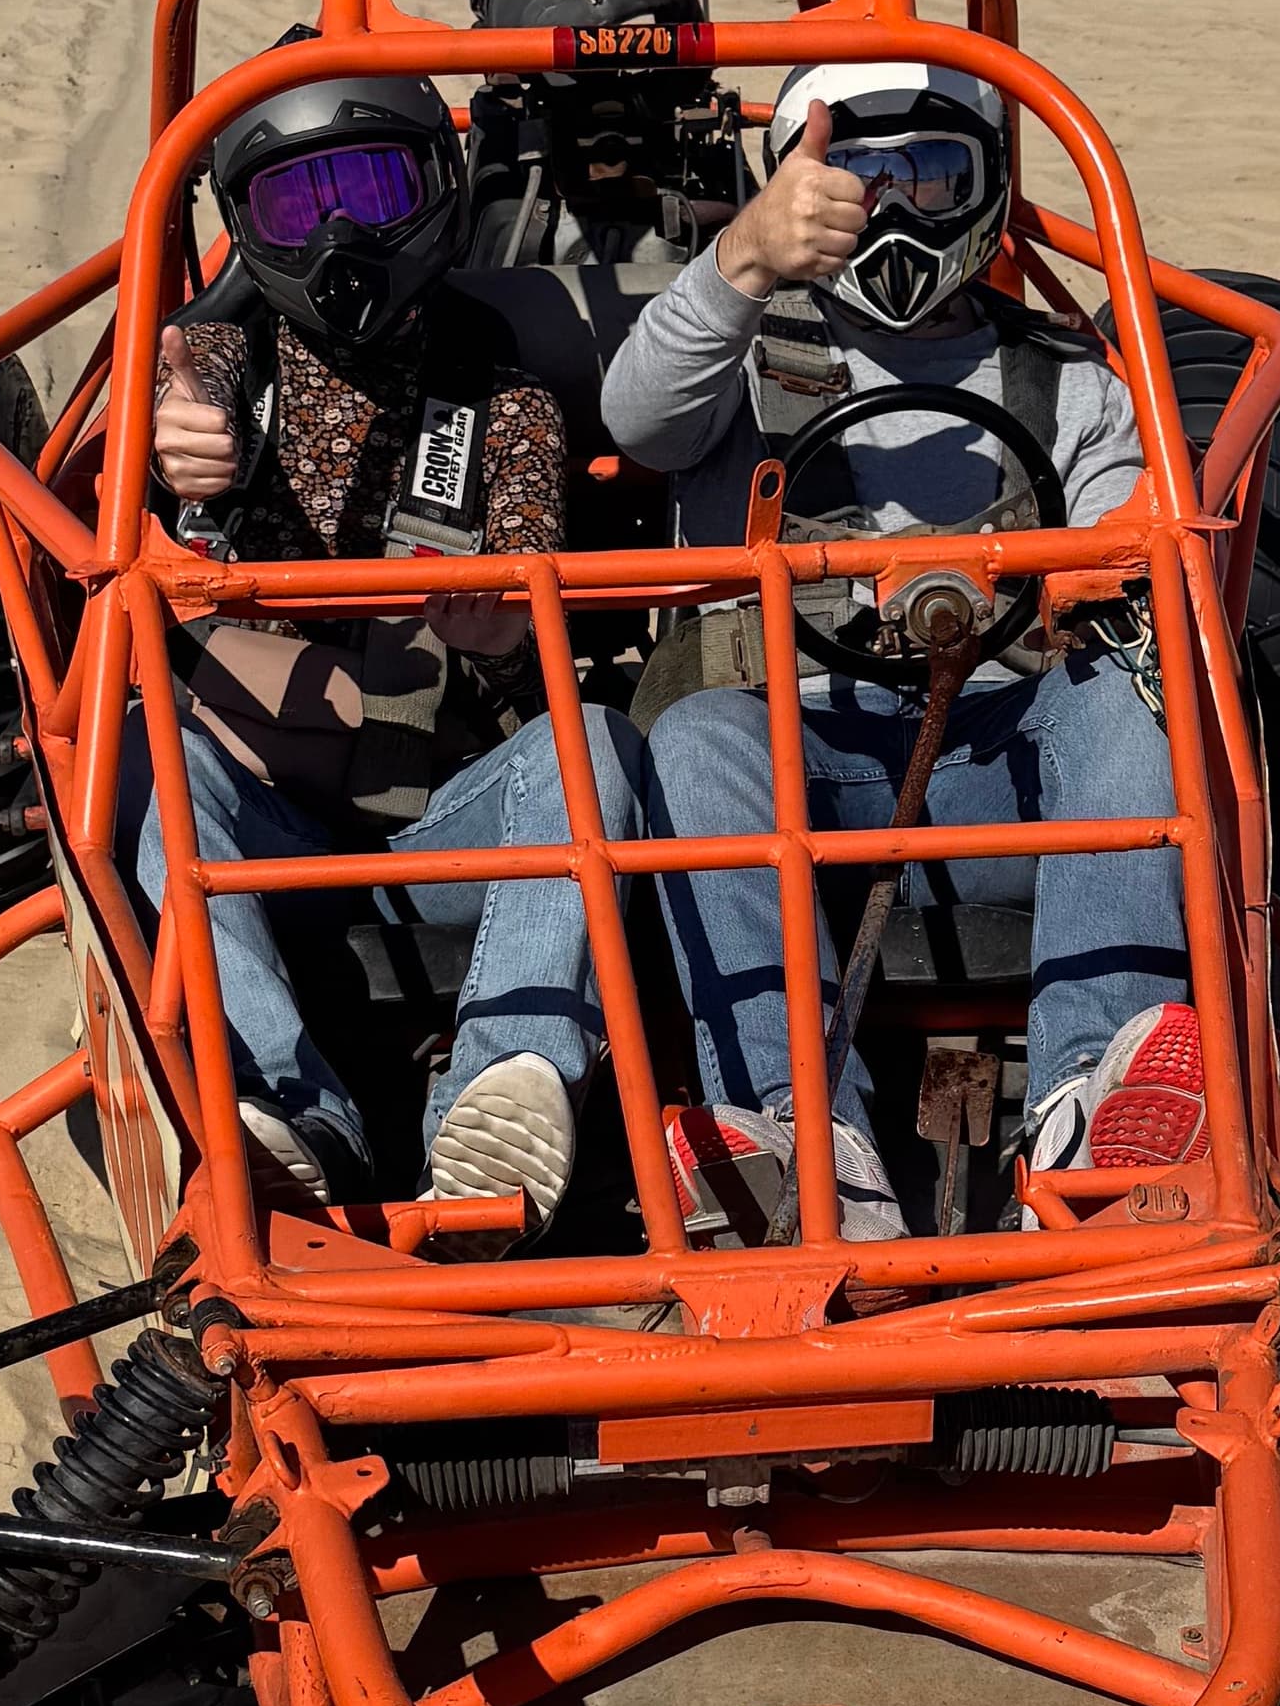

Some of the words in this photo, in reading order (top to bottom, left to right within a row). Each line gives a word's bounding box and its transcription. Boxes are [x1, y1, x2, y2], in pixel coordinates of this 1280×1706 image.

[579, 26, 672, 55] SB220
[421, 429, 455, 498] CROW
[445, 449, 463, 502] SAFETY
[454, 411, 469, 448] GEAR
